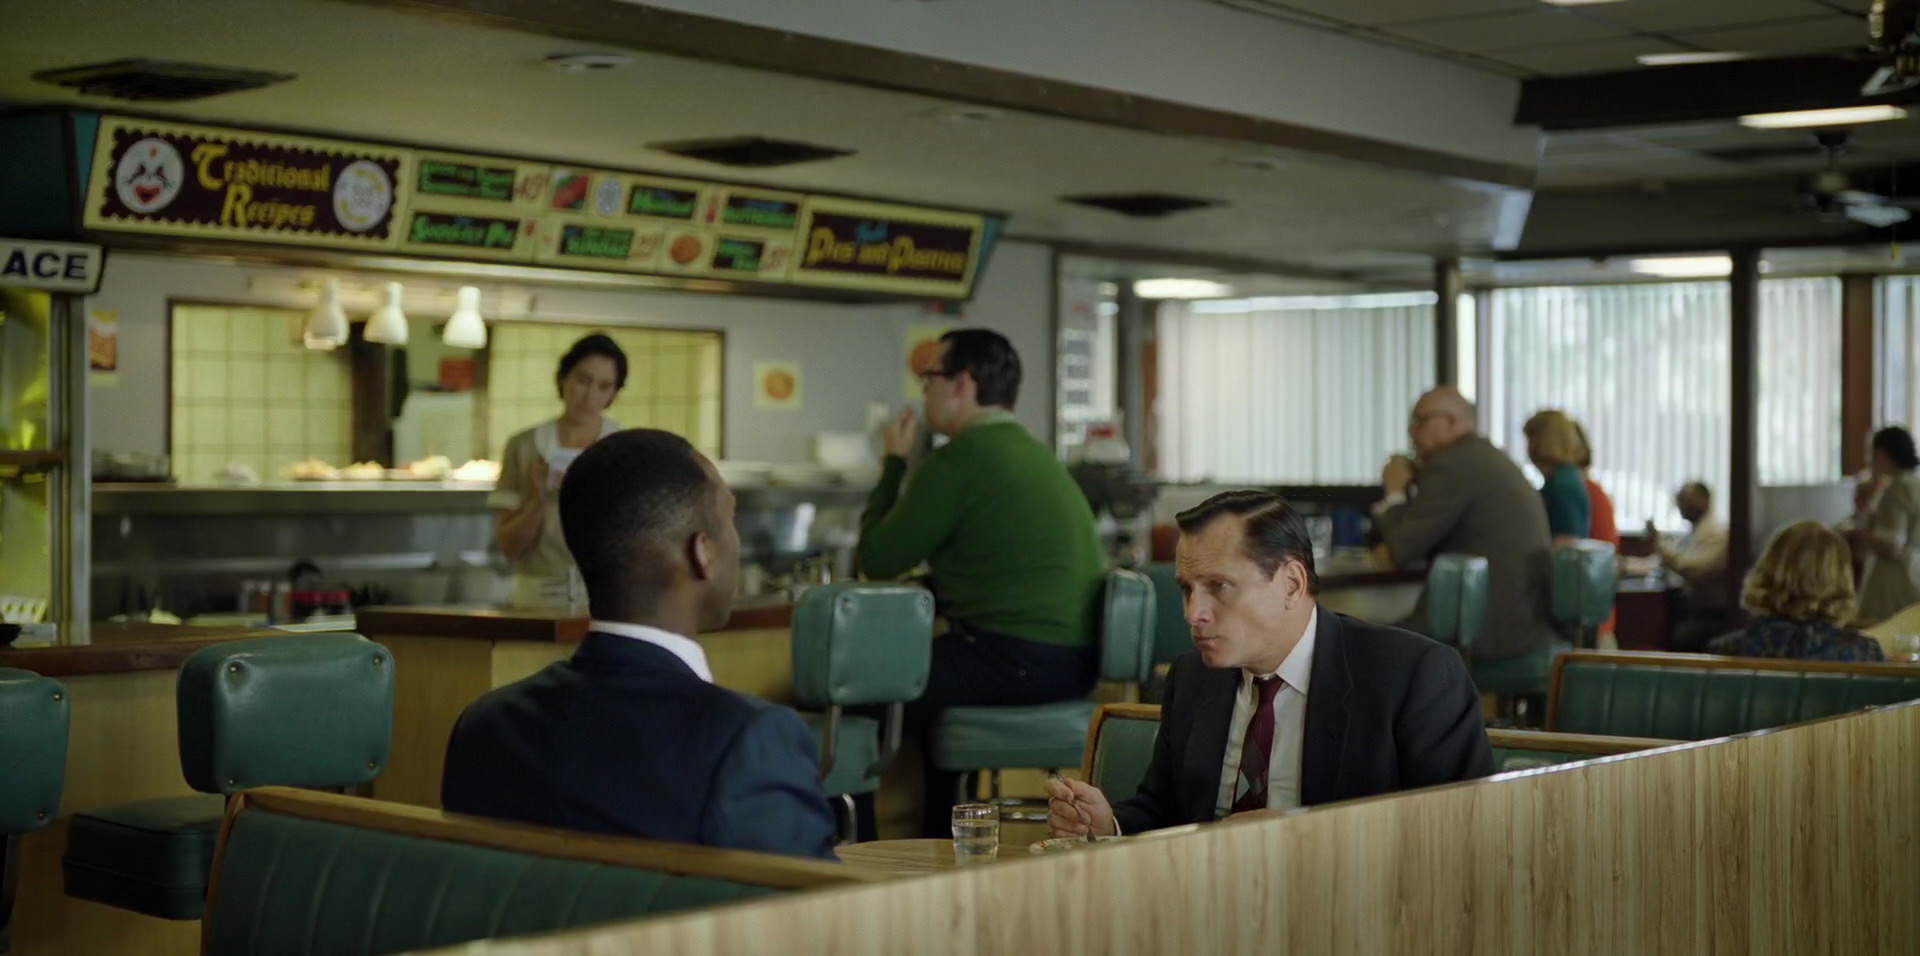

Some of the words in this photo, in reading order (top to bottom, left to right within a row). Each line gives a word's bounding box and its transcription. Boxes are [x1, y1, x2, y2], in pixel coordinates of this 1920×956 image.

[191, 143, 331, 192] Traditional
[222, 184, 317, 227] Recipes
[2, 248, 89, 280] ACE
